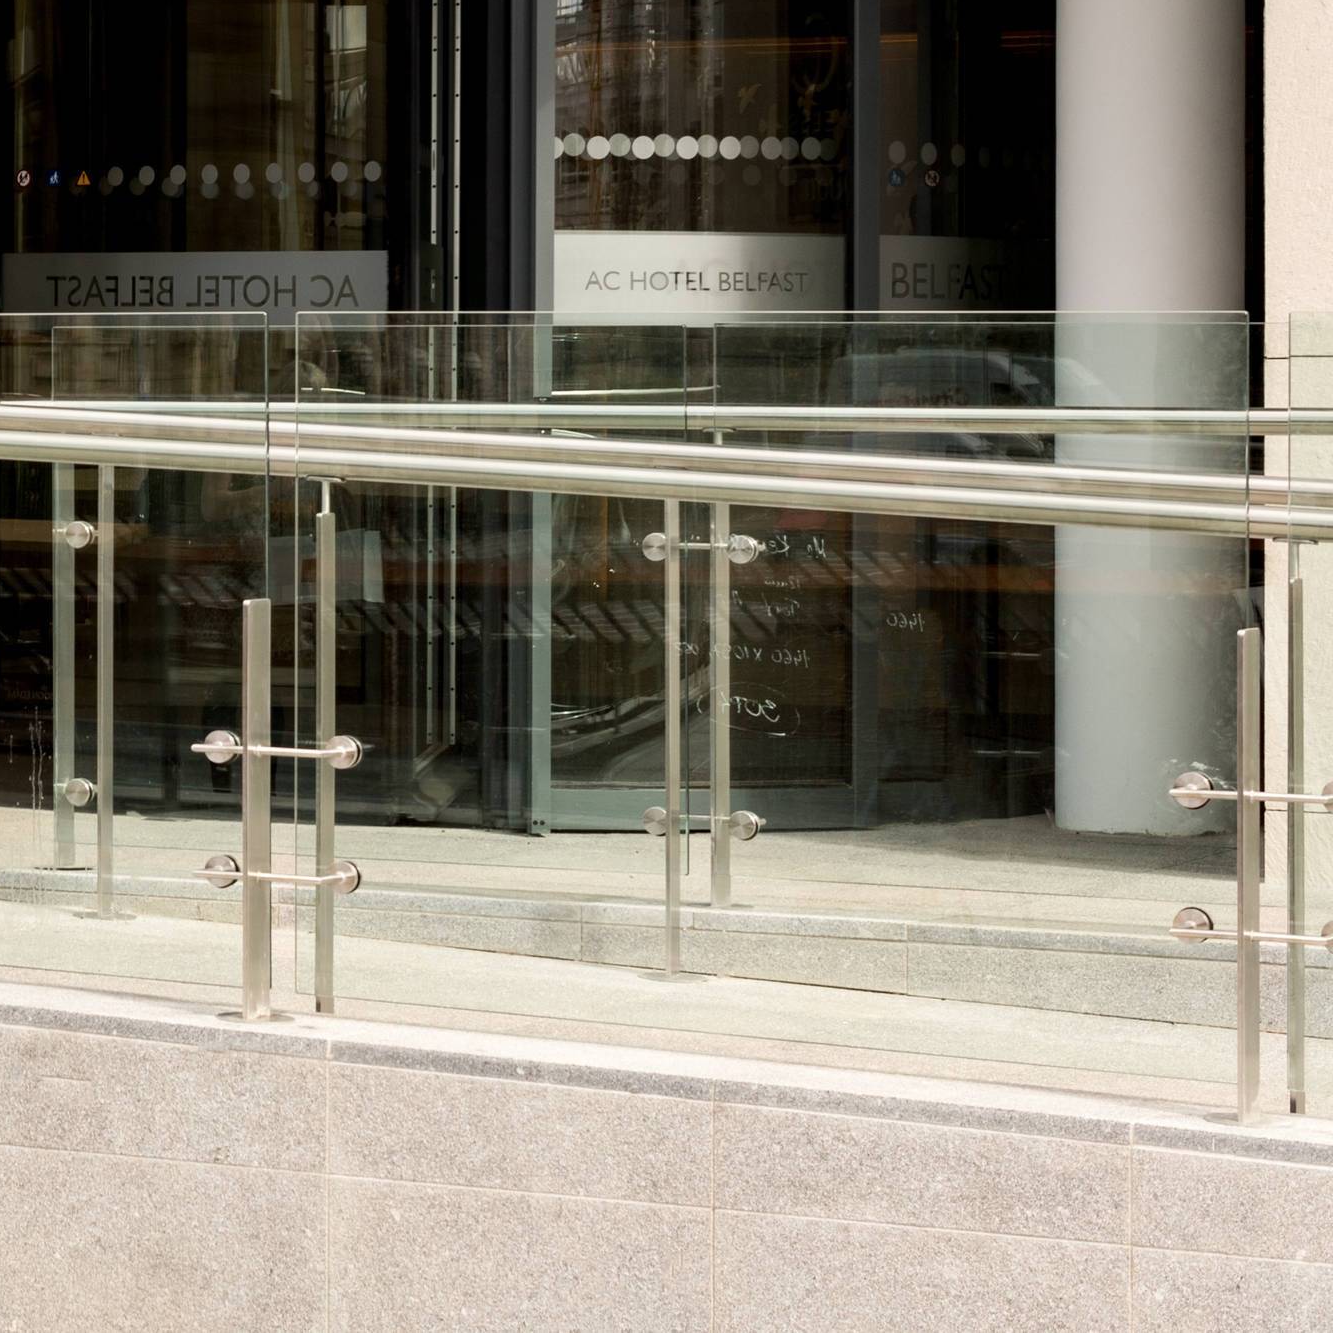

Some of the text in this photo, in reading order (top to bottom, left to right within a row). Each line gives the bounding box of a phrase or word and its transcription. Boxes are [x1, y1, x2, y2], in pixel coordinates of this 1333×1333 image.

[584, 270, 810, 292] AC HOTEL BELFAST
